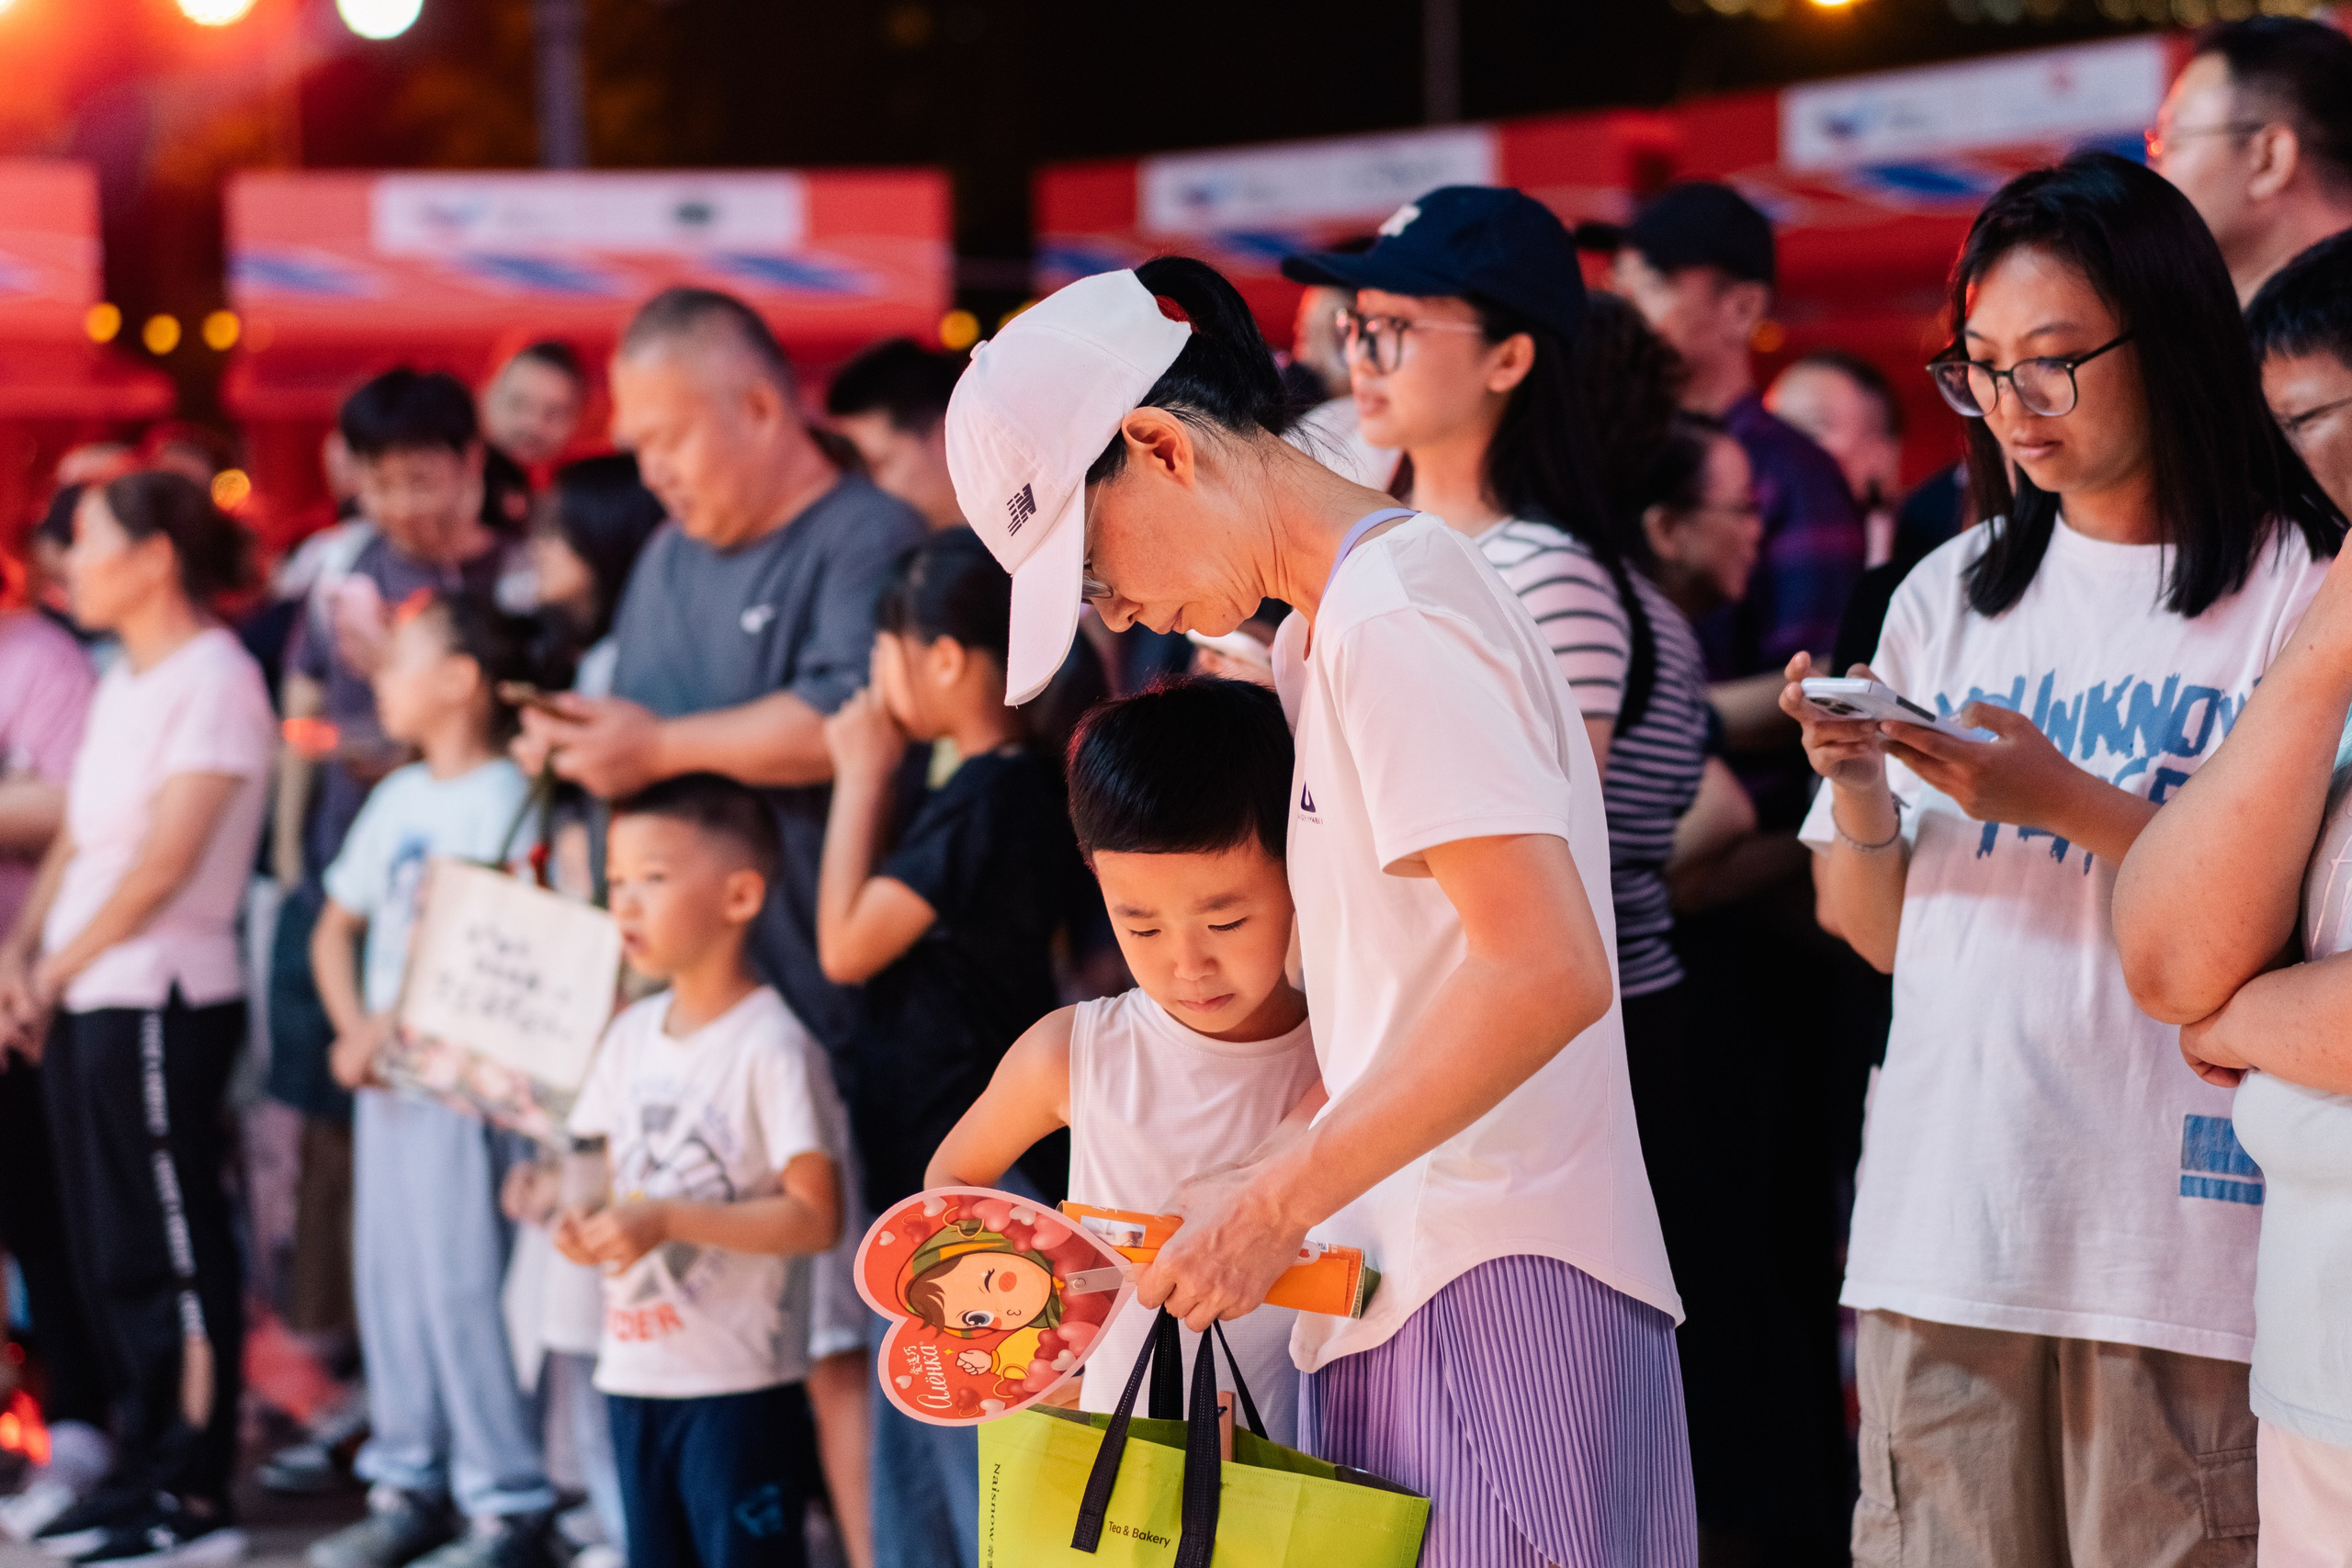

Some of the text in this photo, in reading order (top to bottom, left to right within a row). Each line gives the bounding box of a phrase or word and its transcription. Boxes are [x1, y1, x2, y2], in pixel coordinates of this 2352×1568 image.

[916, 1344, 953, 1409] Алёнка
[988, 1462, 1001, 1542] Naisnow
[1108, 1520, 1171, 1549] Tea & Bakery
